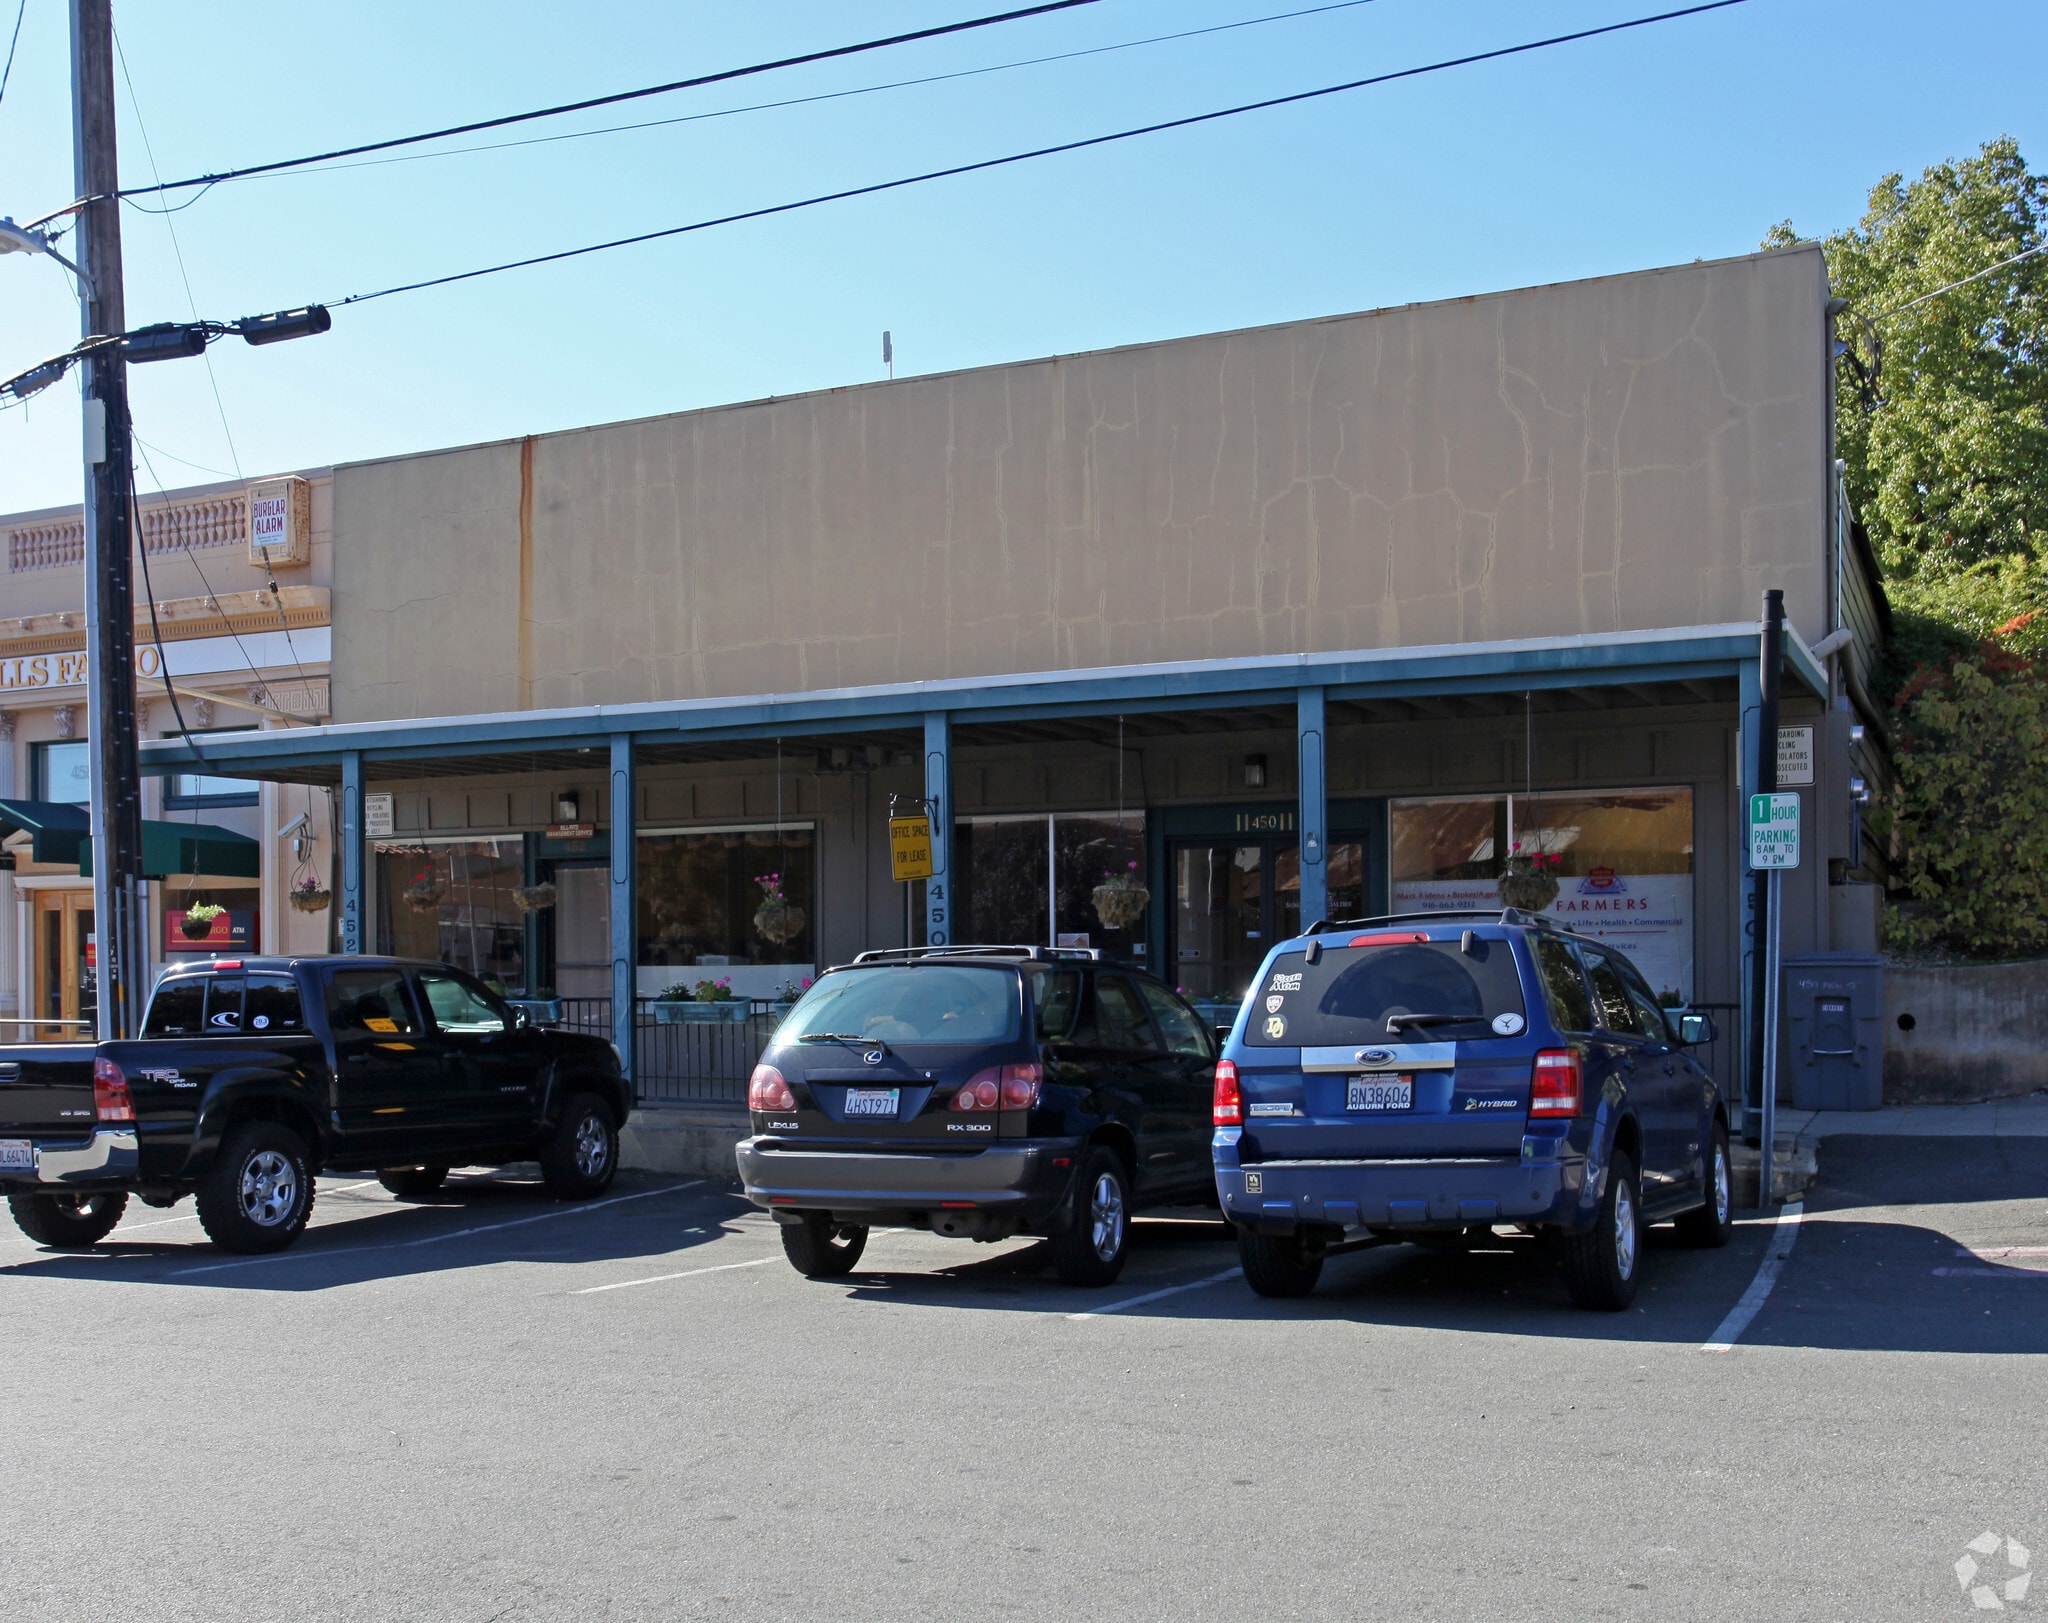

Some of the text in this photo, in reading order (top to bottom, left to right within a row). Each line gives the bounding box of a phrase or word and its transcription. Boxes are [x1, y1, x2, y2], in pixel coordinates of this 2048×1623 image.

[253, 499, 286, 518] BURGLAR
[256, 516, 283, 535] ALARM
[55, 646, 159, 684] FAO
[1777, 730, 1805, 739] OARDING
[1777, 741, 1796, 750] CLING
[1777, 763, 1808, 772] OSECUTED
[1758, 800, 1797, 821] 1 HOUR
[1252, 815, 1277, 829] 450
[892, 824, 929, 839] OFFICE SPACE
[1754, 829, 1796, 844] PARKING
[897, 848, 927, 864] FOR LEASE
[1784, 844, 1794, 854] TO
[1762, 854, 1768, 864] 9
[1556, 898, 1648, 911] FARMERS
[930, 884, 947, 946] 450
[1578, 919, 1593, 927] Life
[1600, 918, 1627, 927] Health
[1634, 917, 1683, 927] Commercial
[210, 926, 245, 935] RGO ATM
[346, 899, 356, 952] 452
[141, 1069, 179, 1082] TRD
[1350, 1086, 1409, 1103] 8N38606
[847, 1098, 895, 1114] 4HST971
[1478, 1100, 1518, 1108] HYBRID
